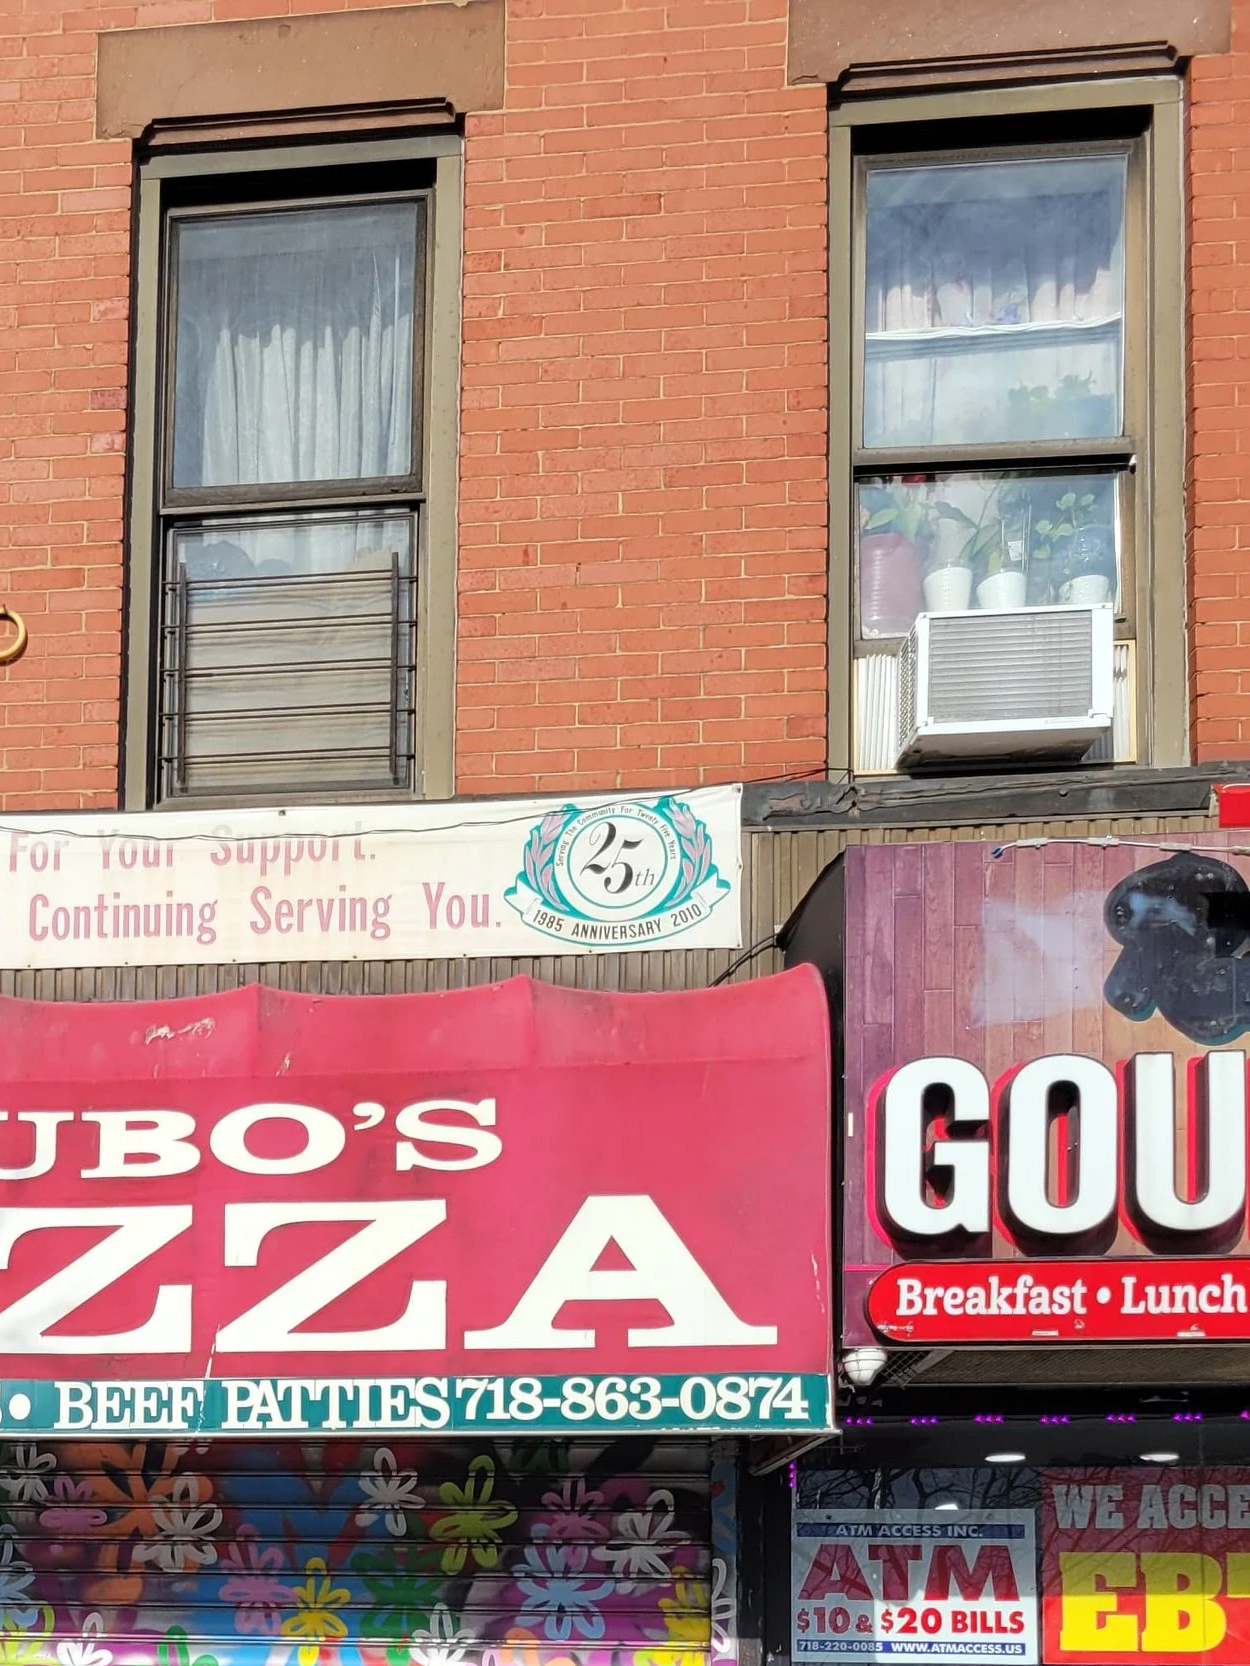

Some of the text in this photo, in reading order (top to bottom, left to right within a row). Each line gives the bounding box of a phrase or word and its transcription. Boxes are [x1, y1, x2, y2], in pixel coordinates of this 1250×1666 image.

[577, 806, 616, 826] Community
[620, 805, 634, 815] For
[8, 830, 68, 873] For
[98, 828, 175, 870] Your
[210, 823, 377, 879] Support.
[579, 821, 655, 894] 25th
[28, 889, 218, 945] Continuing
[249, 885, 393, 939] Serving
[422, 881, 502, 931] You.
[532, 903, 702, 940] 1985 ANNIVERSARY 2010
[895, 1273, 1248, 1317] Breakfast Lunch
[55, 1379, 205, 1431] BEEF
[220, 1376, 452, 1431] PATTIES
[454, 1374, 810, 1424] 718-863-0874
[1052, 1484, 1124, 1530] WE
[836, 1524, 983, 1538] ATM ACCESS INC.
[798, 1543, 1021, 1602] ATM
[797, 1606, 1025, 1635] $10 & $20 BILLS
[799, 1641, 1023, 1655] 718-220-0085 WWW.ATMACCESS.US
